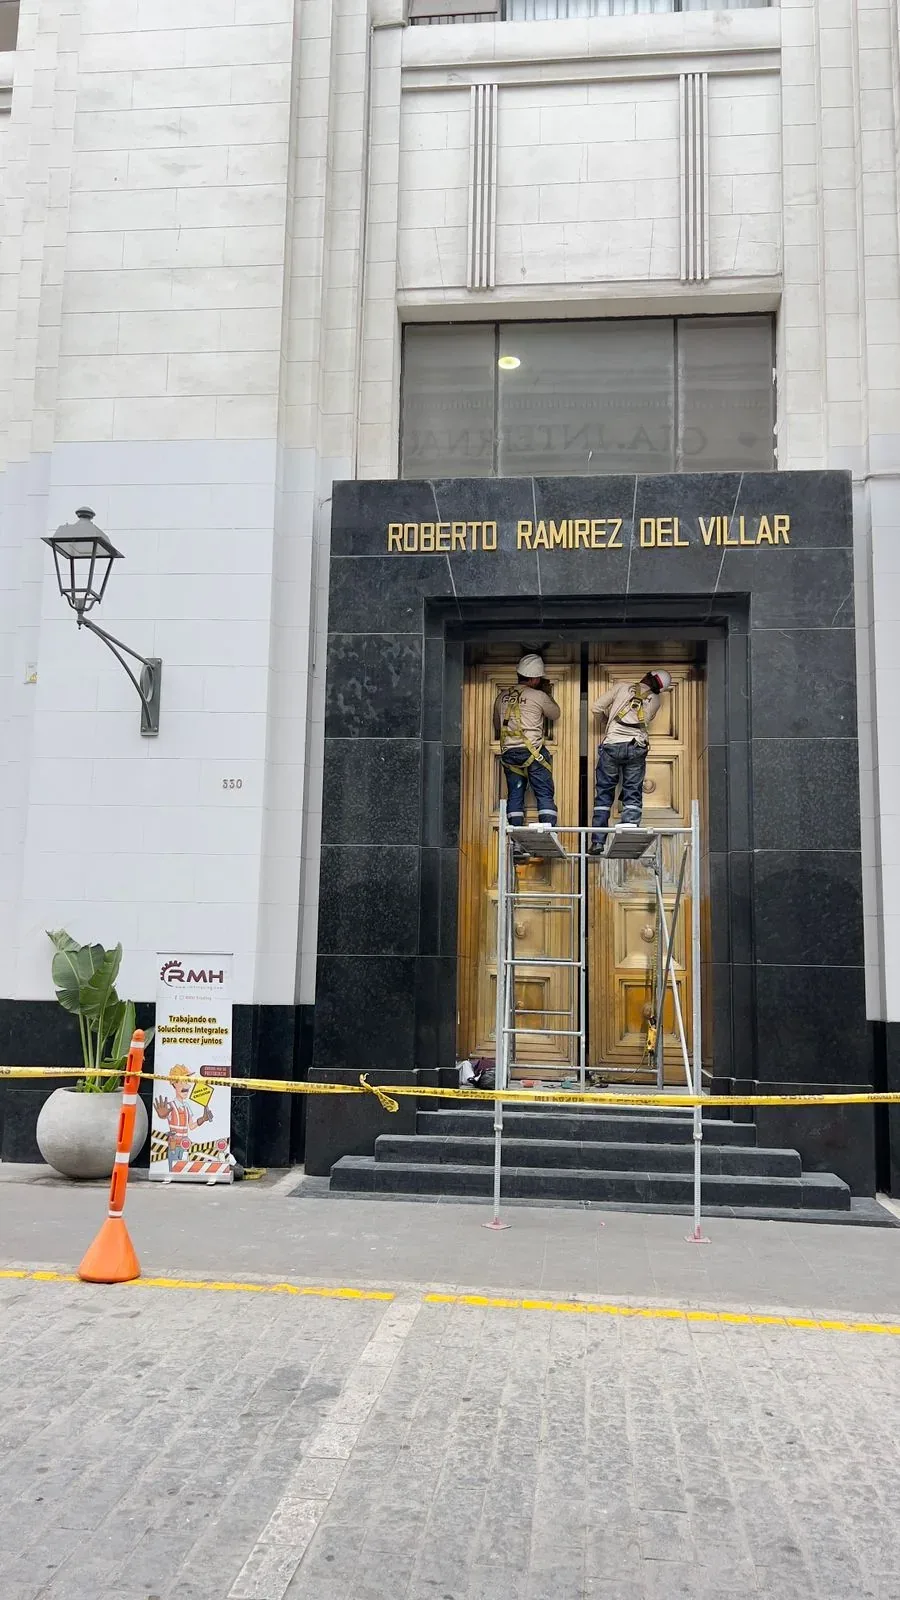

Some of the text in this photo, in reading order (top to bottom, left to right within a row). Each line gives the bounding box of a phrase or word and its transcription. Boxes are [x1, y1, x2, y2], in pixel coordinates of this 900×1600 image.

[387, 514, 791, 552] ROBERTO RAMIREZ DEL VILLAR
[168, 969, 224, 983] RMH
[168, 1015, 206, 1024] Trabajando
[157, 1025, 229, 1036] Soluciones Integrales
[162, 1036, 177, 1045] para
[201, 1036, 223, 1046] juntos
